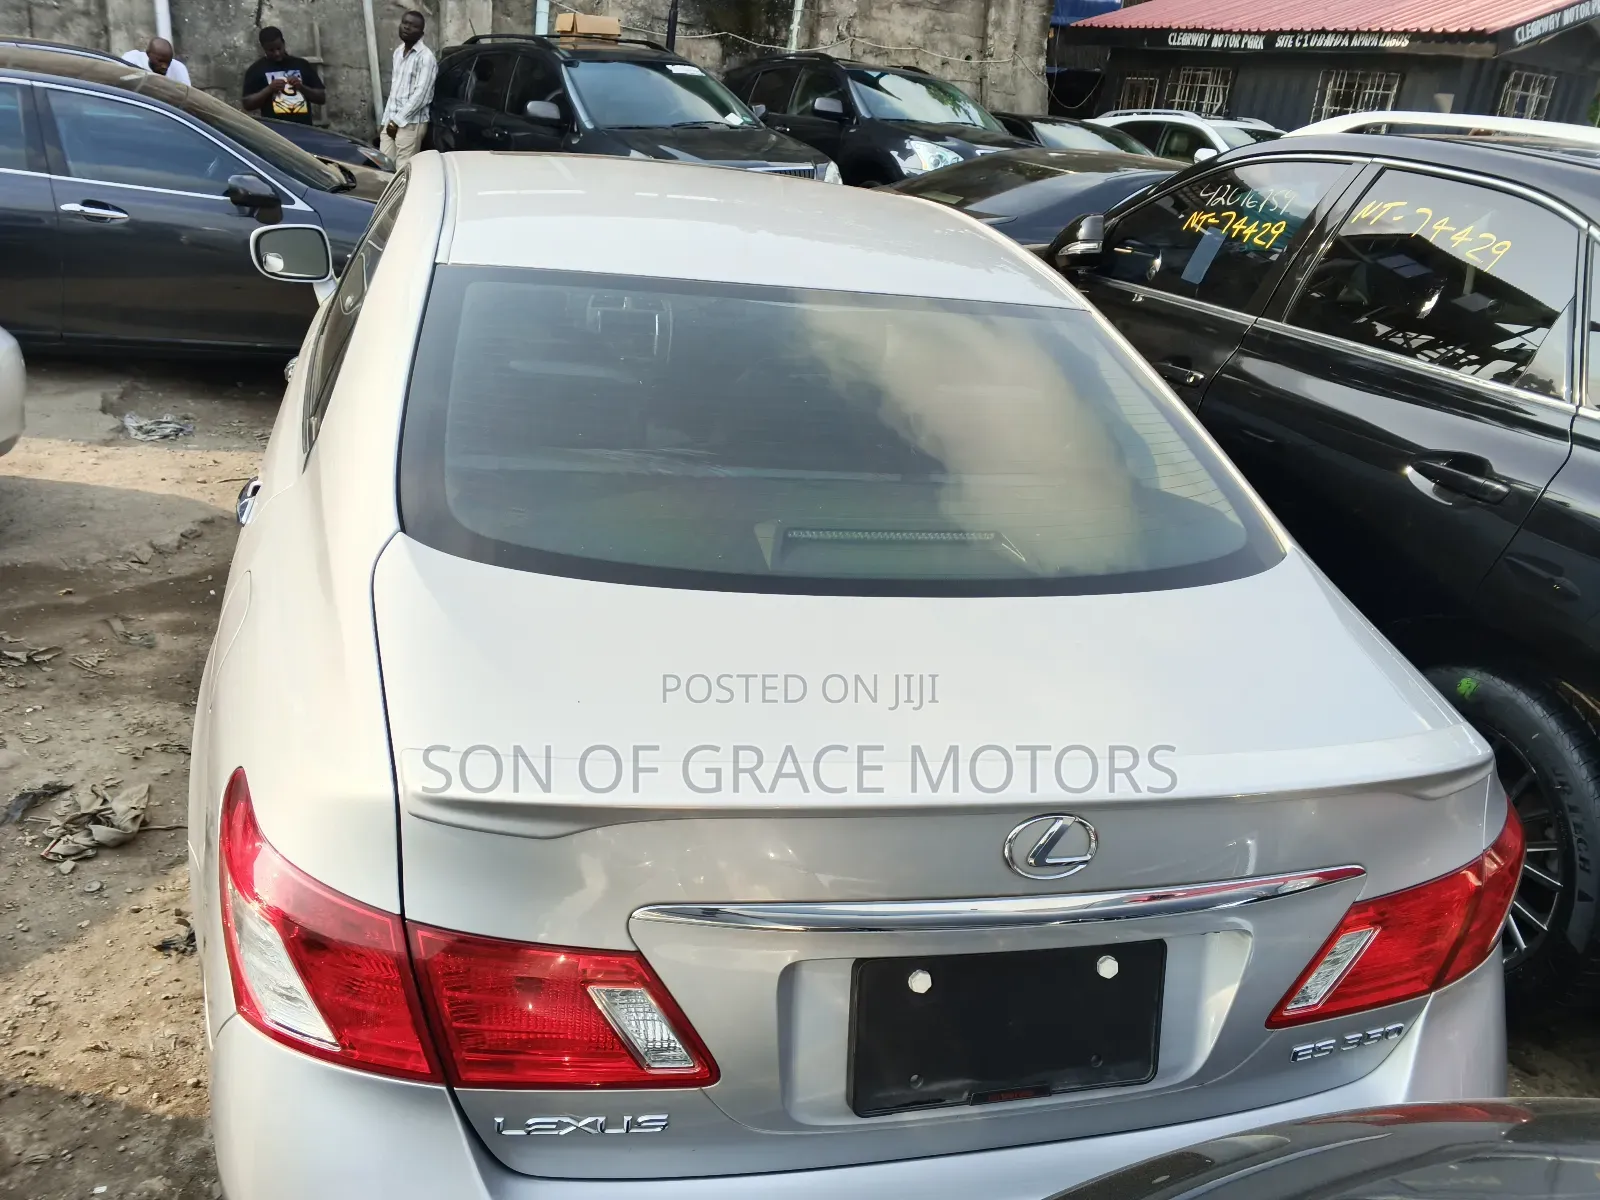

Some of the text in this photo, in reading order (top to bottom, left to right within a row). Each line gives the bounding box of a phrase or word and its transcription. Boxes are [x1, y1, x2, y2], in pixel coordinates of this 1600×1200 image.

[1563, 1, 1591, 25] MOTOR
[1211, 33, 1242, 48] MOTOR
[1275, 34, 1295, 48] SITE
[1378, 33, 1411, 47] LAGOS
[1290, 1023, 1405, 1062] ES 350
[494, 1113, 669, 1136] LEXUS
